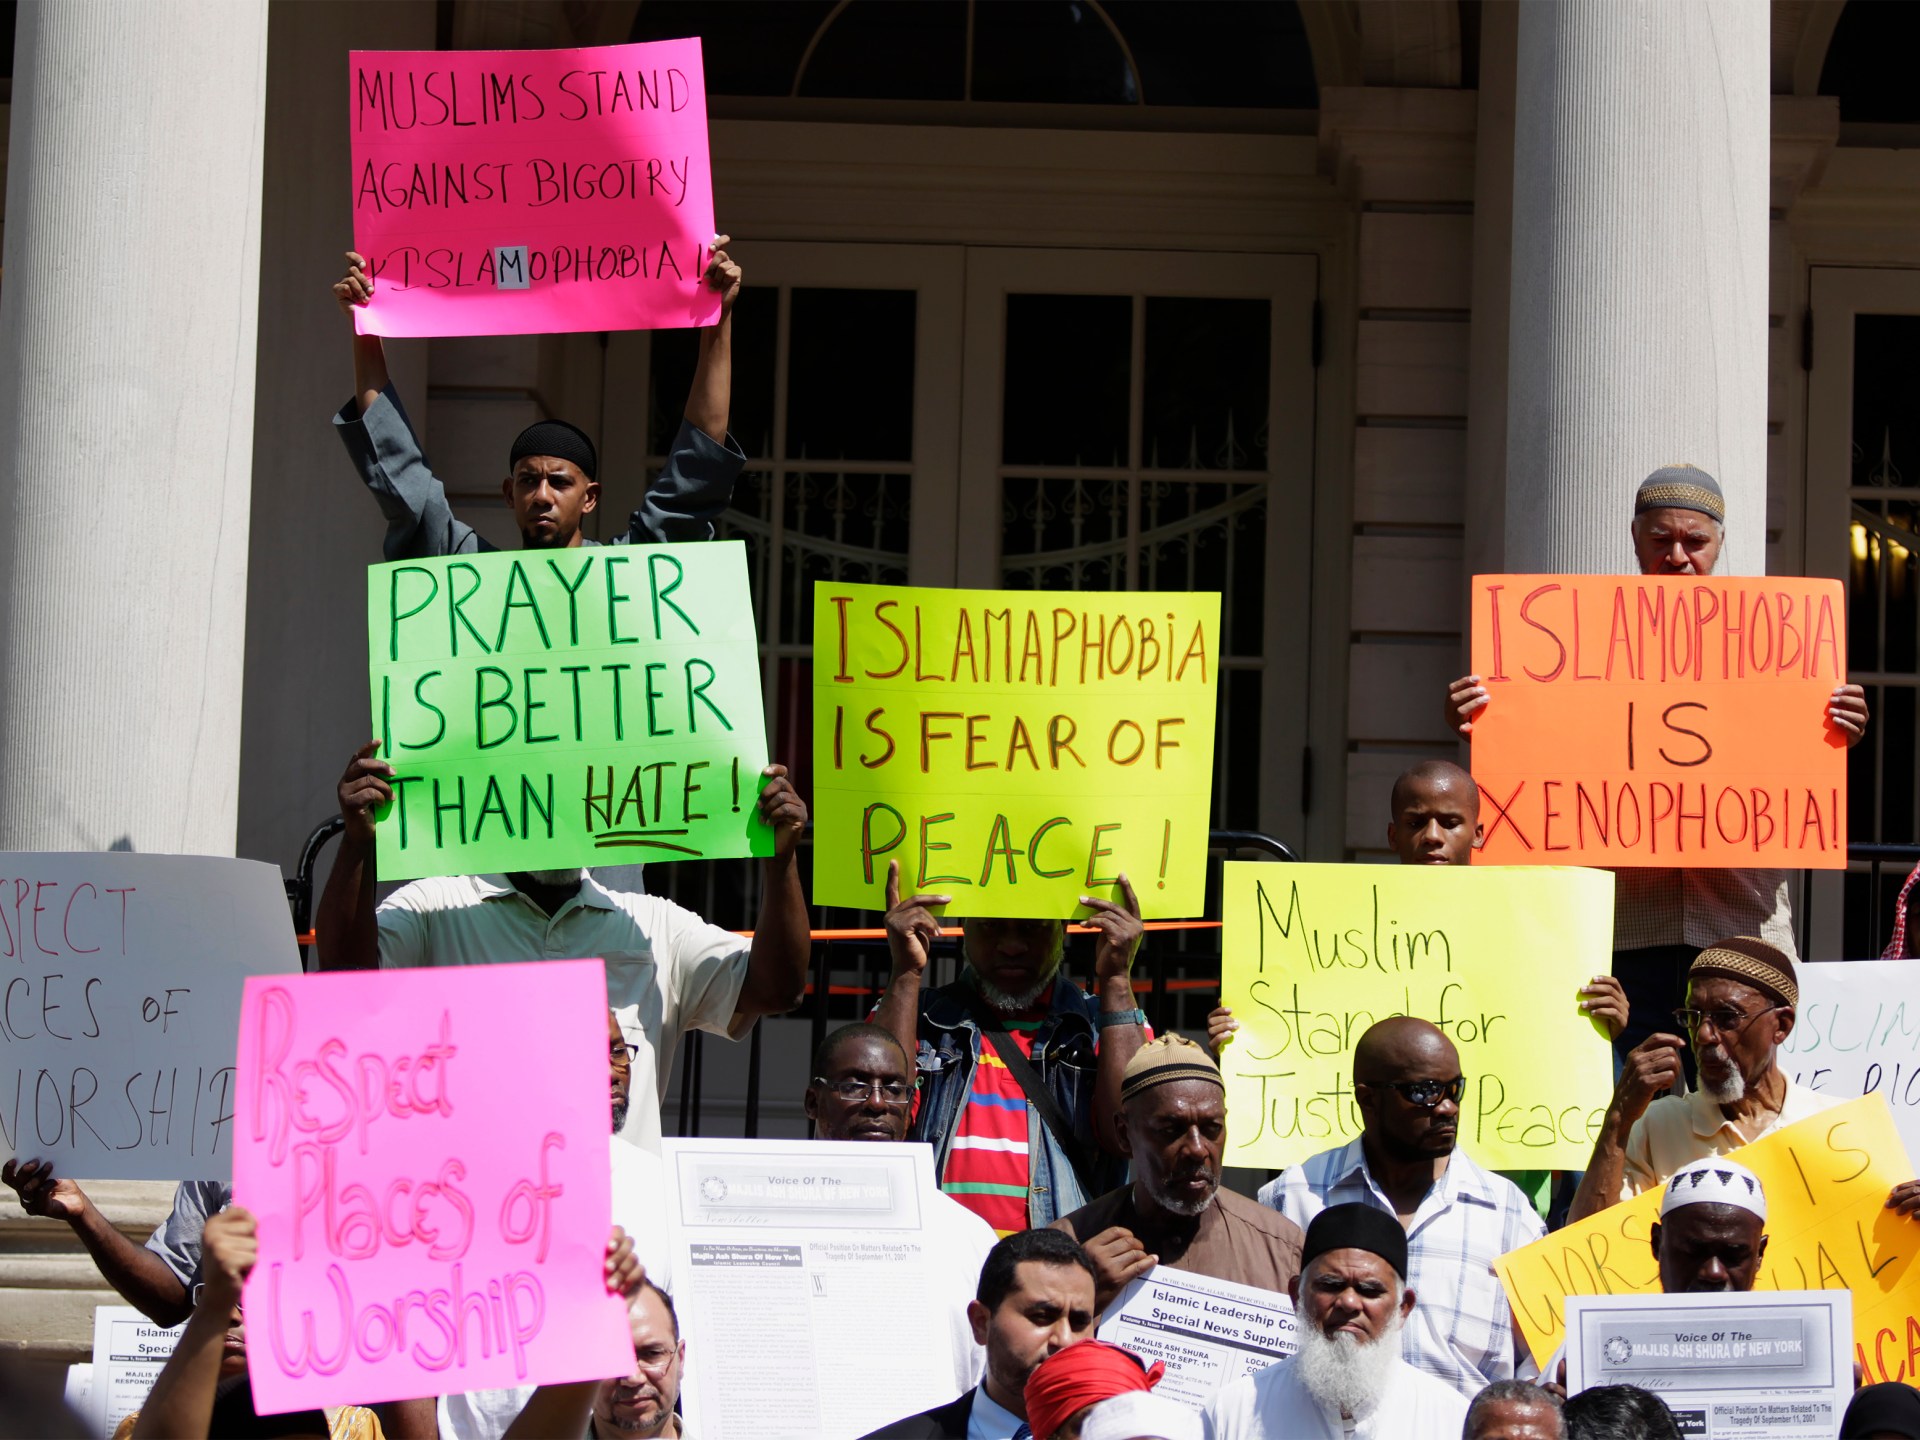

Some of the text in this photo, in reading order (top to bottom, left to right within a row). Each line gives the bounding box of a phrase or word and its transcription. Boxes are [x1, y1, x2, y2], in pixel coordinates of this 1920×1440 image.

[358, 67, 690, 132] MUSLIMS STAND
[357, 156, 689, 213] AGAINST BIGOTRY
[389, 553, 701, 662] PRAYER
[1485, 583, 1840, 683] ISLAMOPHOBIA
[381, 657, 735, 759] IS BETTER
[1626, 701, 1713, 770] IS
[833, 704, 1186, 774] IS FEAR OF
[386, 773, 554, 850] THAN
[1476, 780, 1840, 854] XENOPHOBIA!
[1256, 879, 1451, 974] Muslim
[0, 974, 103, 1043] CES
[1434, 983, 1507, 1045] for
[1236, 1071, 1608, 1149] Justi Peace
[767, 1176, 842, 1186] Voice Of The
[1788, 1121, 1871, 1206] IS
[500, 1131, 566, 1265] of
[809, 1242, 921, 1253] Official Position On Matters Related To The
[825, 1252, 847, 1262] Tragedy
[847, 1252, 854, 1260] Of
[855, 1252, 884, 1262] September
[894, 1253, 907, 1261] 2001
[136, 1328, 181, 1338] Islamic
[269, 1261, 547, 1380] Worship
[1122, 1315, 1141, 1325] Volume
[1151, 1307, 1200, 1329] Special
[1203, 1320, 1240, 1338] News
[1152, 1288, 1200, 1309] Islamic
[1203, 1301, 1274, 1328] Leadership
[1675, 1332, 1752, 1343] Voice Of The
[1121, 1342, 1163, 1358] RESPONDS
[1166, 1352, 1176, 1361] TO
[1177, 1355, 1200, 1367] SEPT.
[1133, 1336, 1209, 1360] MAJLIS ASH SHURA
[1632, 1339, 1803, 1359] MAJLIS ASH SHURA OF NEW YORK
[115, 1378, 155, 1386] RESPONDS
[1714, 1403, 1832, 1415] Official Position On Matters Related To The
[1730, 1416, 1752, 1426] Tragedy
[1753, 1415, 1761, 1424] Of
[1761, 1415, 1791, 1425] September
[1802, 1414, 1816, 1423] 2001
